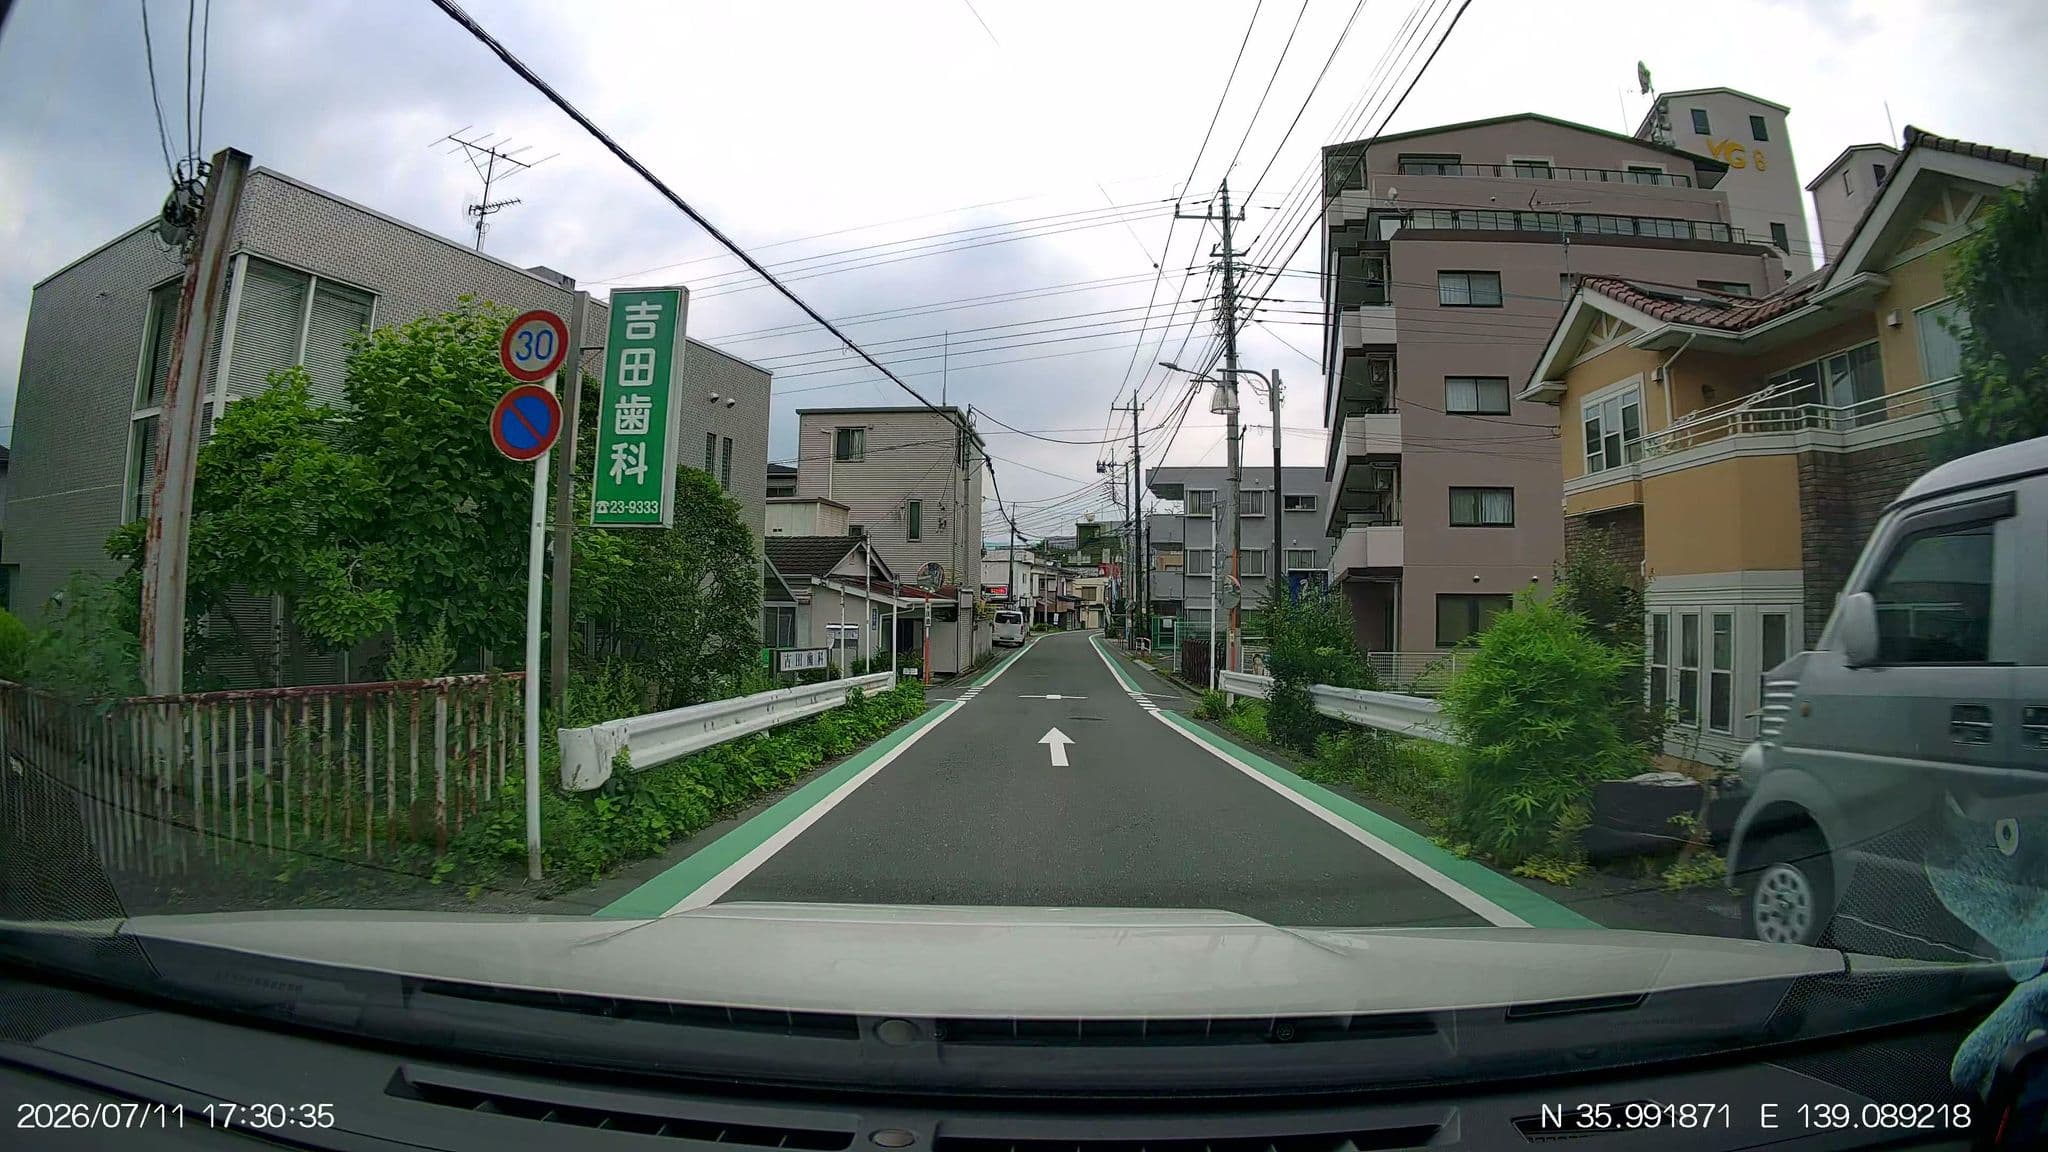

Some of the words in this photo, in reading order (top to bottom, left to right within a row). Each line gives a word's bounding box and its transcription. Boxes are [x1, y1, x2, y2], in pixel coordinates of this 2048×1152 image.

[515, 329, 554, 362] 30
[609, 300, 663, 486] 吉田歯科
